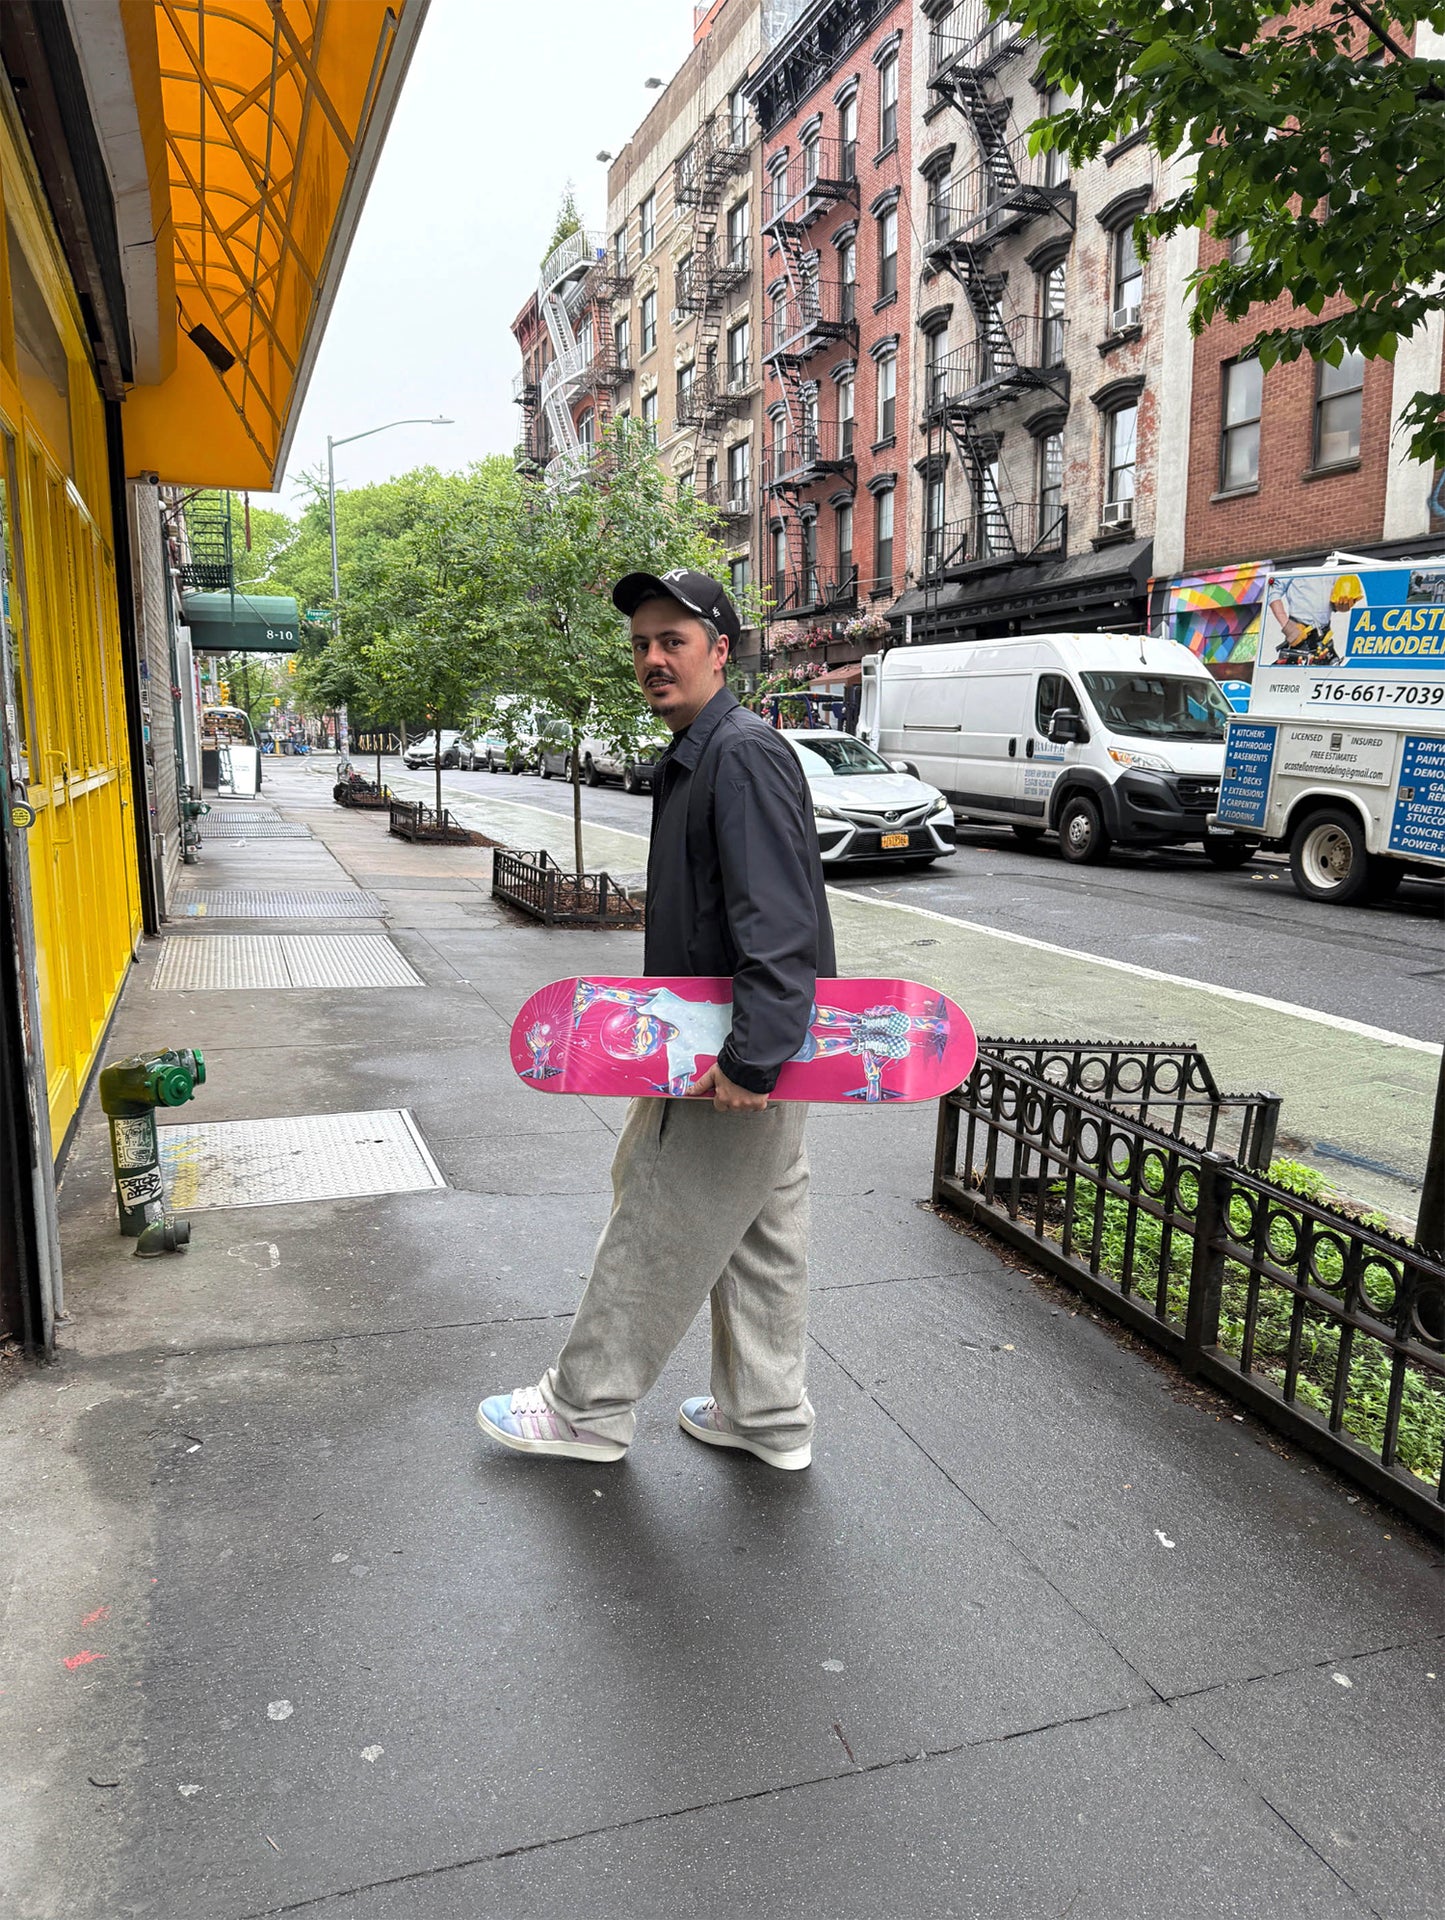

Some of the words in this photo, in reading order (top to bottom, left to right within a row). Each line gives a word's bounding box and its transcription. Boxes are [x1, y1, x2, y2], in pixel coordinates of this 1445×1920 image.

[1354, 610, 1377, 632] A.
[266, 629, 293, 640] 8-10
[1269, 684, 1300, 693] INTERIOR
[1311, 683, 1444, 705] 516-661-7039
[1236, 728, 1266, 739] KITCHENS
[1290, 732, 1324, 742] LICENSED
[1350, 737, 1384, 747] INSURED
[1235, 740, 1273, 752] BATHROOMS
[1233, 752, 1269, 763] BASEMENTS
[1310, 751, 1325, 760] FREE
[1325, 752, 1358, 763] ESTIMATES
[1415, 754, 1445, 766] PAINT
[1244, 764, 1258, 774] TILE
[1413, 767, 1445, 780] DEMO
[1242, 776, 1263, 786] DECKS
[1228, 786, 1265, 799] EXTENSIONS
[1429, 782, 1445, 793] GA
[1226, 798, 1261, 811] CARPENTRY
[1408, 802, 1445, 817] VENETI
[1224, 809, 1256, 822] FLOORING
[1405, 812, 1445, 826] STUCCO
[1403, 825, 1445, 840] CONCRE
